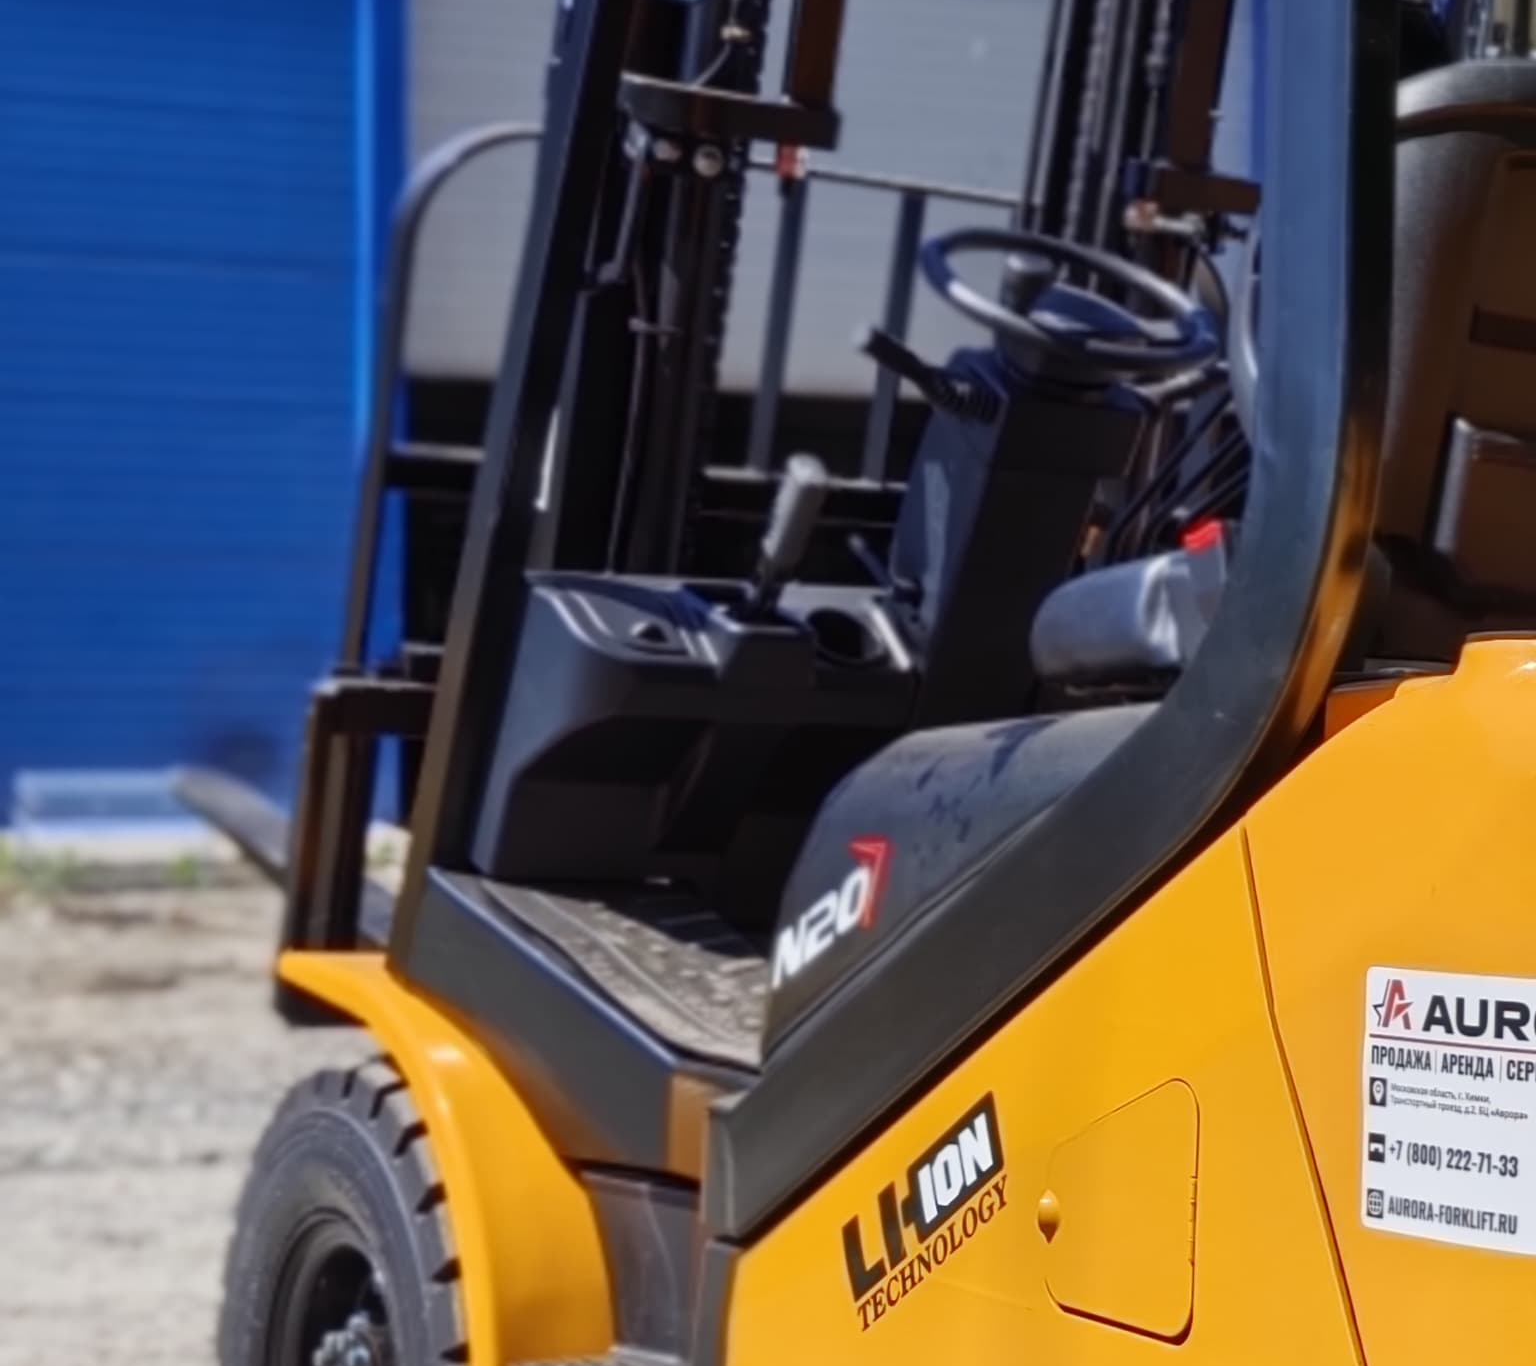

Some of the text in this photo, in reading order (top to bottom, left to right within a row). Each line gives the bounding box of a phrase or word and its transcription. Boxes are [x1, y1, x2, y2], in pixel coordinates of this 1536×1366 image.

[1371, 1045, 1432, 1071] ПРОДАЖА
[1441, 1053, 1494, 1081] АРЕНДА
[1389, 1140, 1519, 1178] +7 (800) 222-71-33
[1387, 1195, 1518, 1235] AURORA-FORKLIFT.RU
[857, 1174, 1007, 1332] TECHNOLOGY
